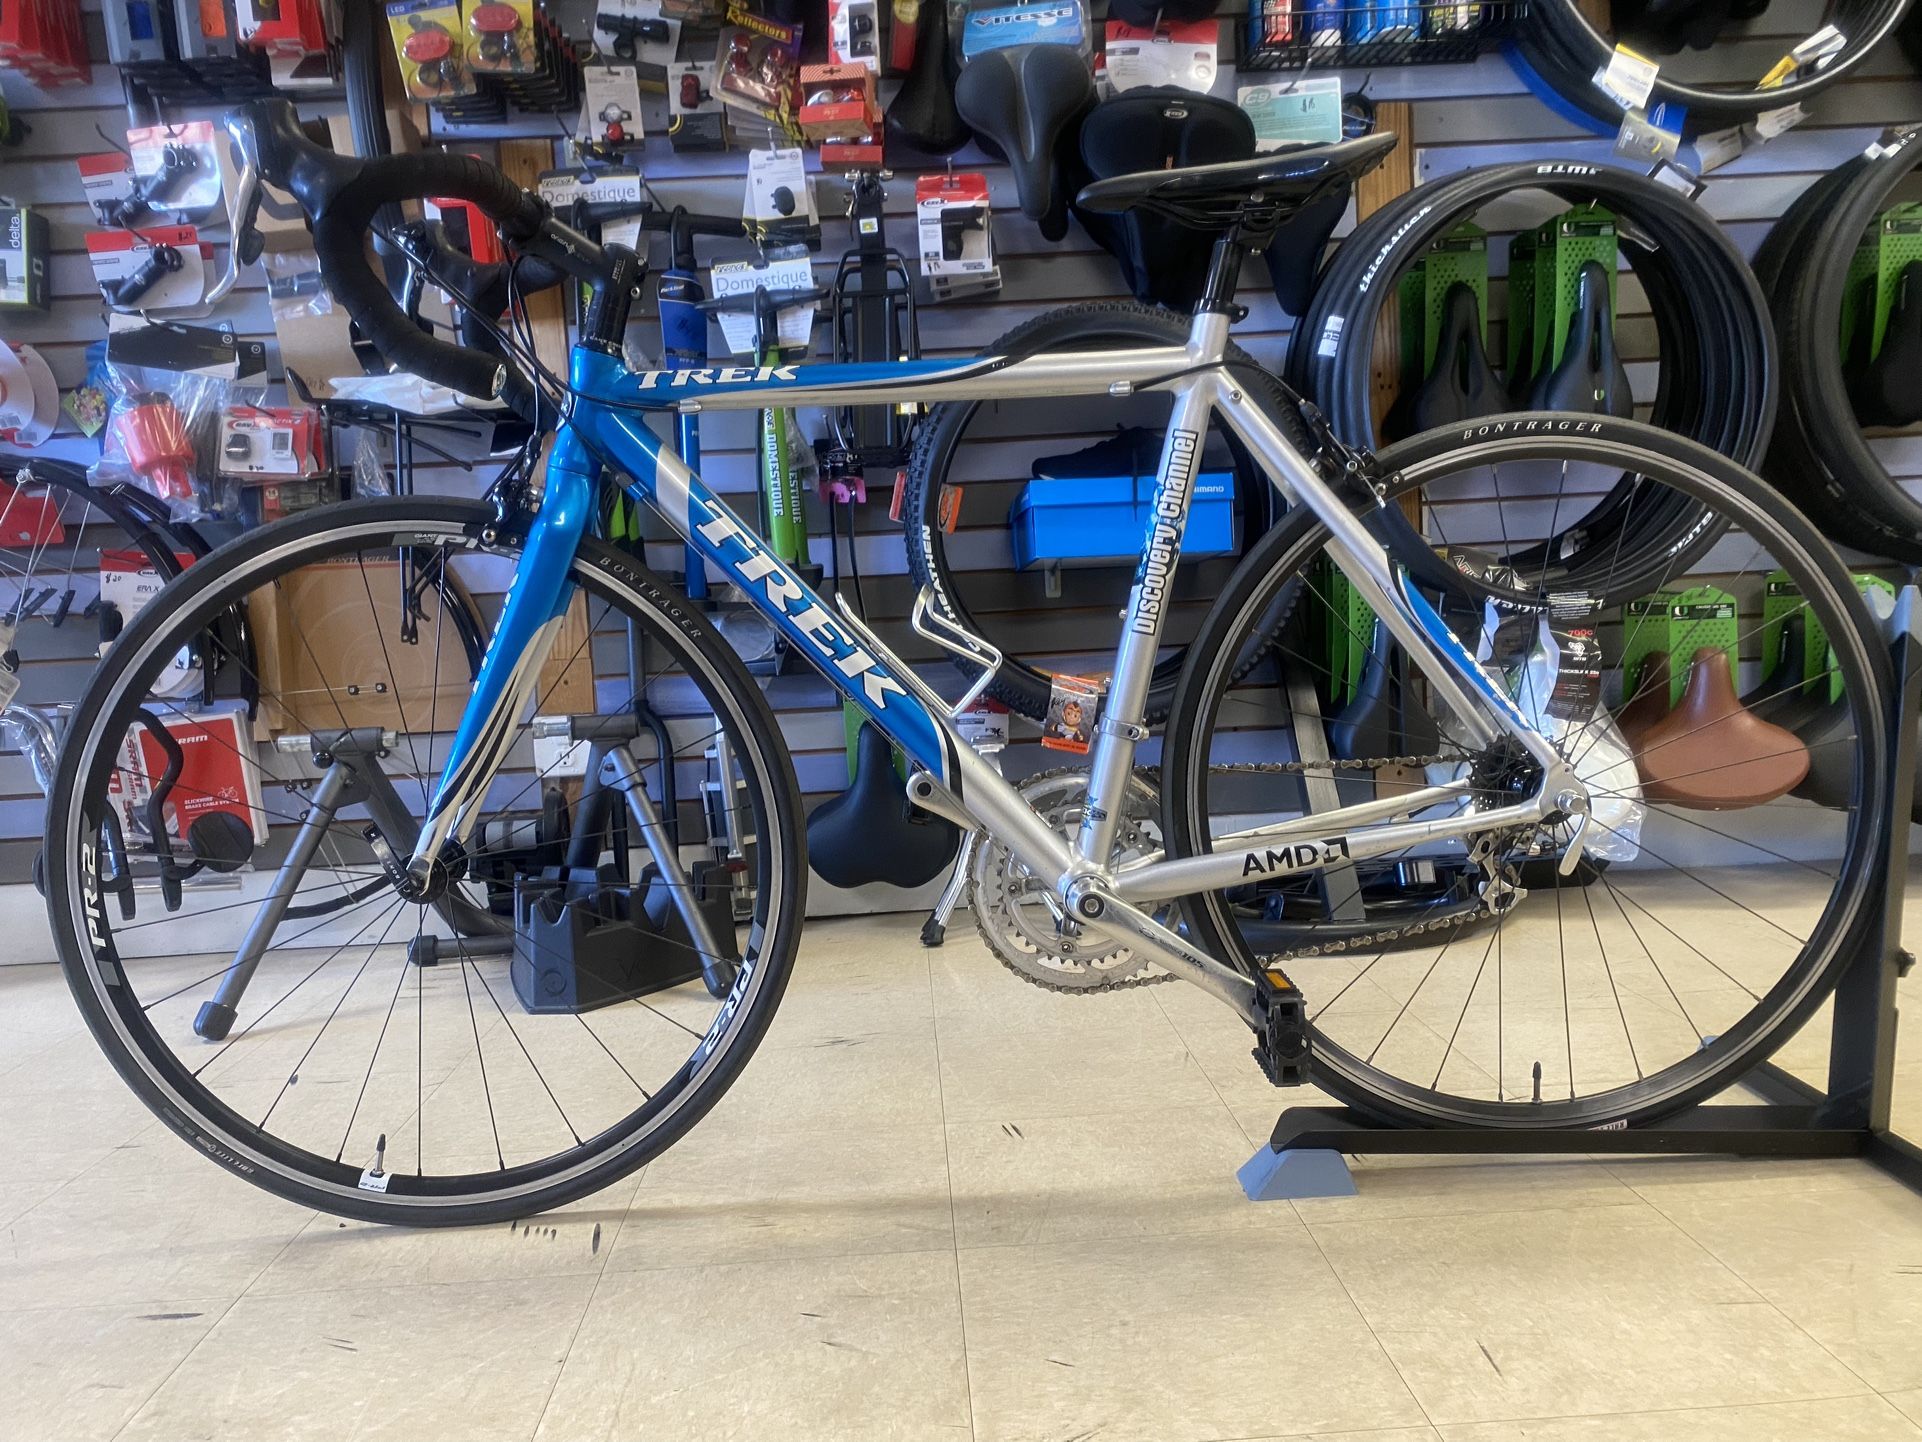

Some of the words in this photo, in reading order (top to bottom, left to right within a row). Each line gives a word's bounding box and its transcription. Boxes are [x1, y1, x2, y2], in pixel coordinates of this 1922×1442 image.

[542, 186, 636, 203] Domestique
[9, 216, 21, 248] delta
[715, 270, 808, 293] Domestique
[635, 365, 800, 390] TREK
[1463, 420, 1603, 440] BONTRAGER
[766, 431, 785, 517] DOMESTIQUE
[599, 556, 703, 639] BONTRAGER
[696, 499, 908, 710] TREK
[176, 734, 208, 745] RAM
